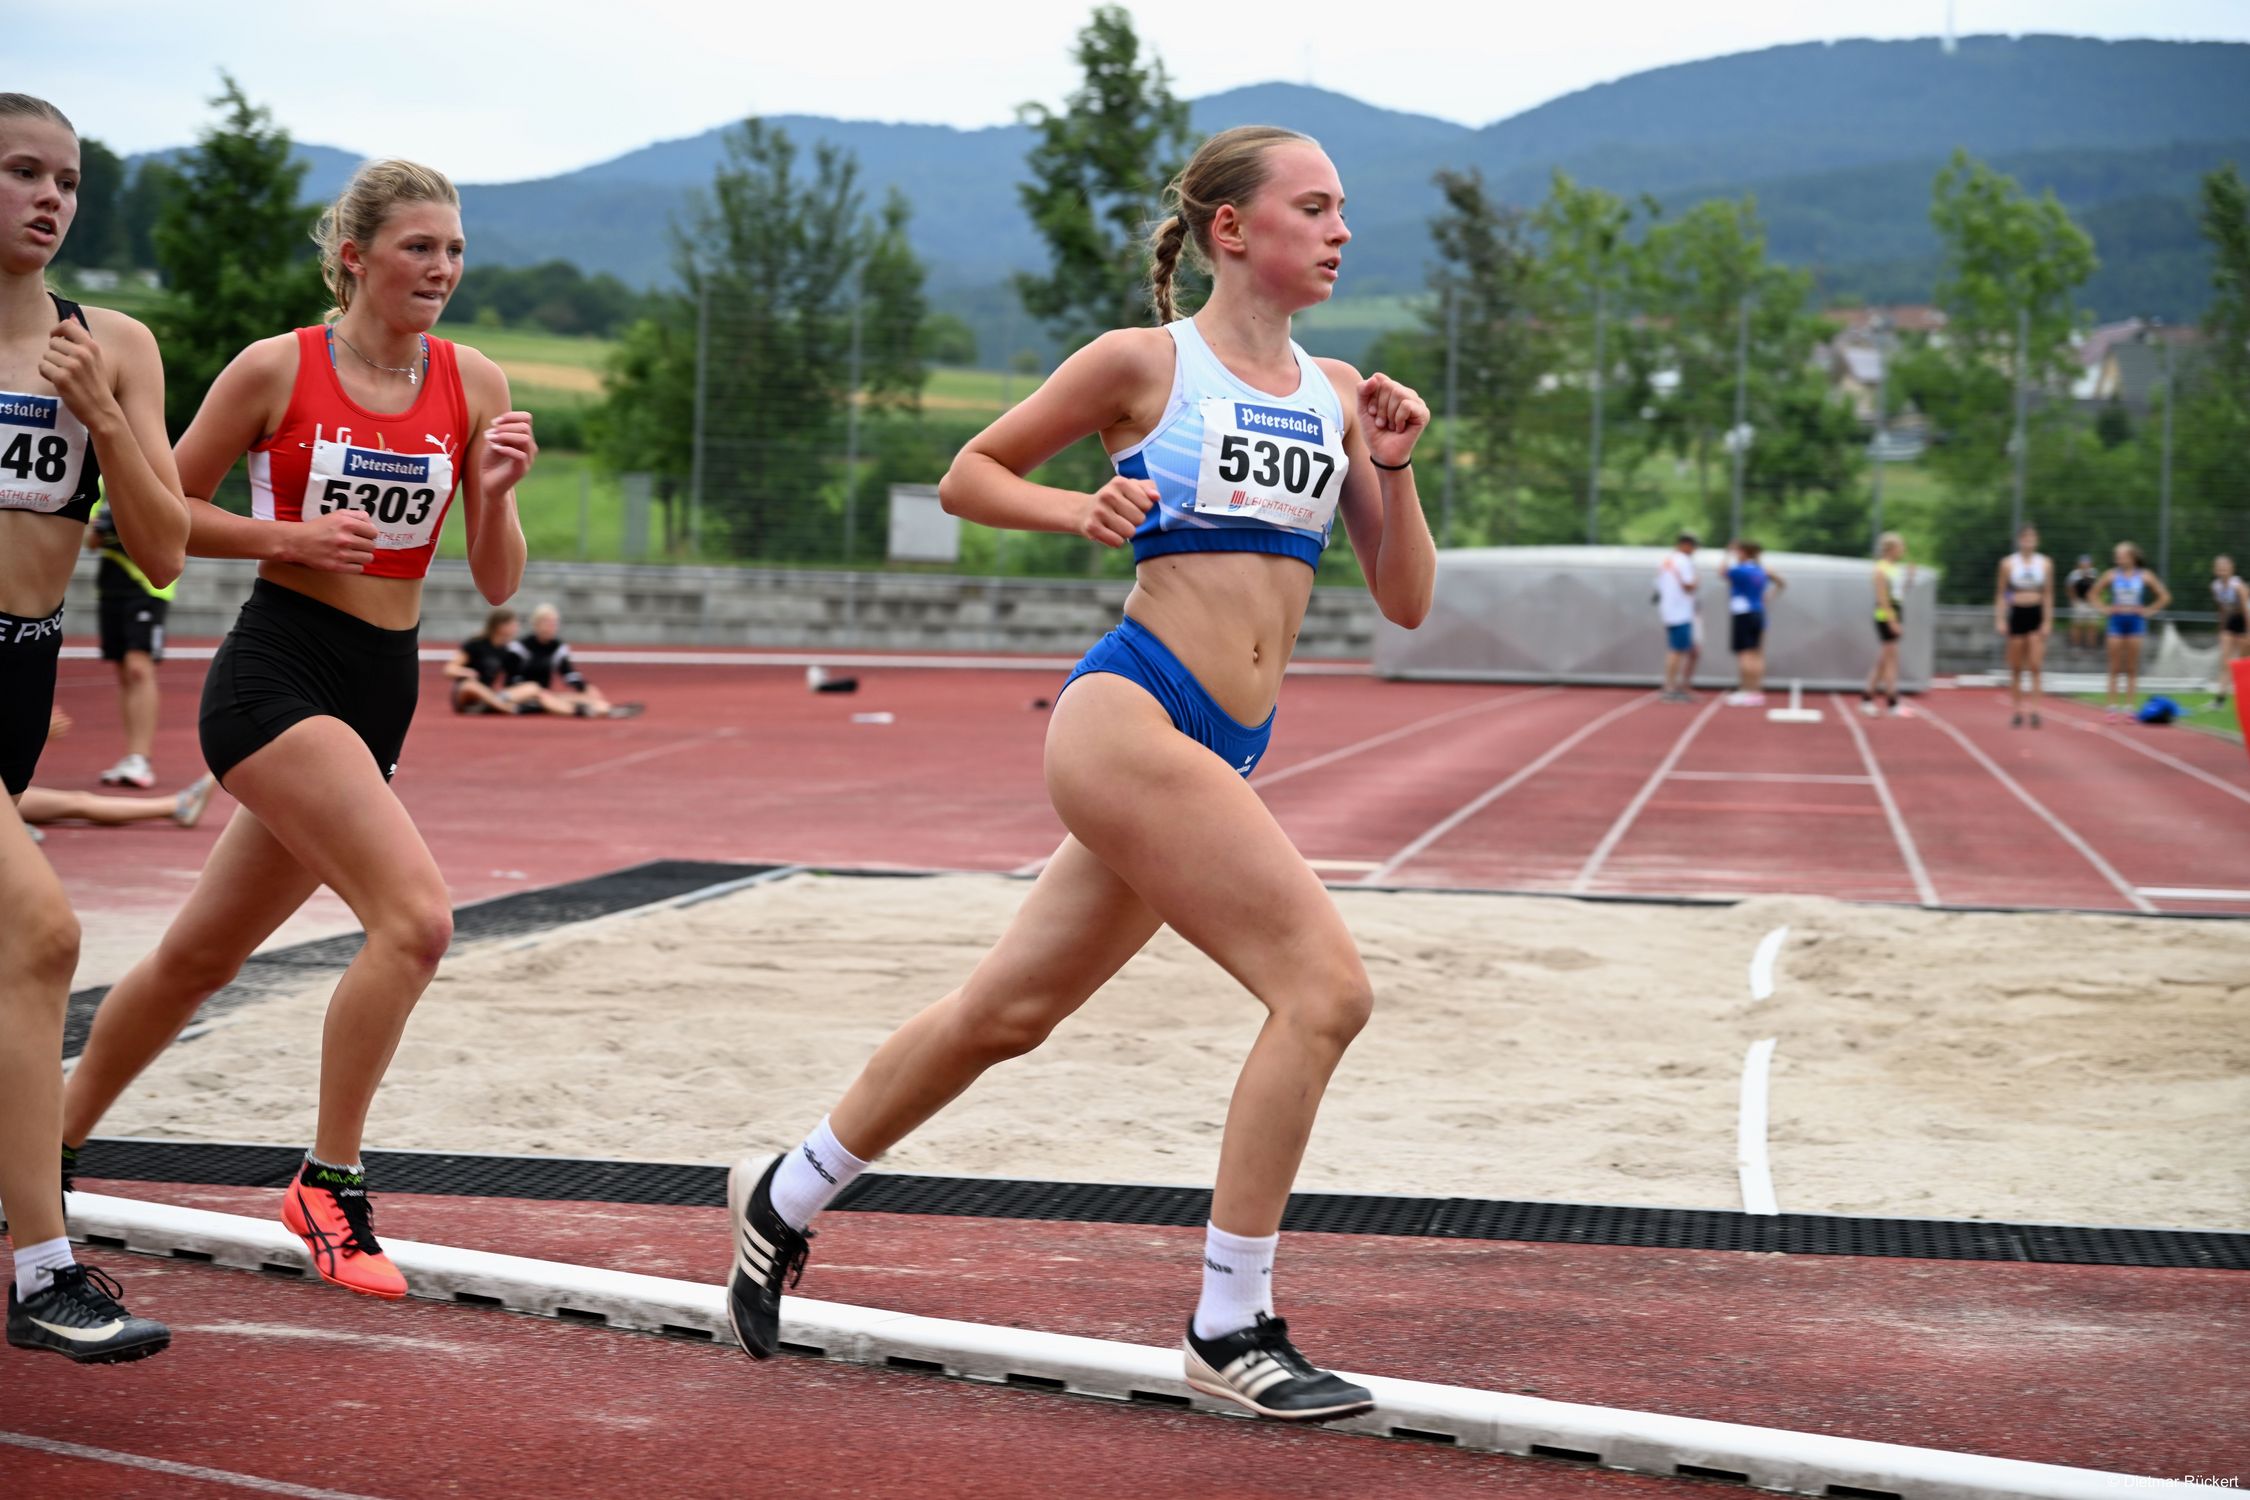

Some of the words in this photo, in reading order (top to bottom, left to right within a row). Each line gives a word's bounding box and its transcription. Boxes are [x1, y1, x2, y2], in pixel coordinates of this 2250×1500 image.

[1241, 407, 1320, 437] Peterstaler
[0, 432, 69, 483] 48
[349, 453, 426, 476] Peterstaler
[1218, 434, 1336, 500] 5307
[319, 479, 436, 526] 5303
[1244, 496, 1316, 519] LEICHTATHLETIK
